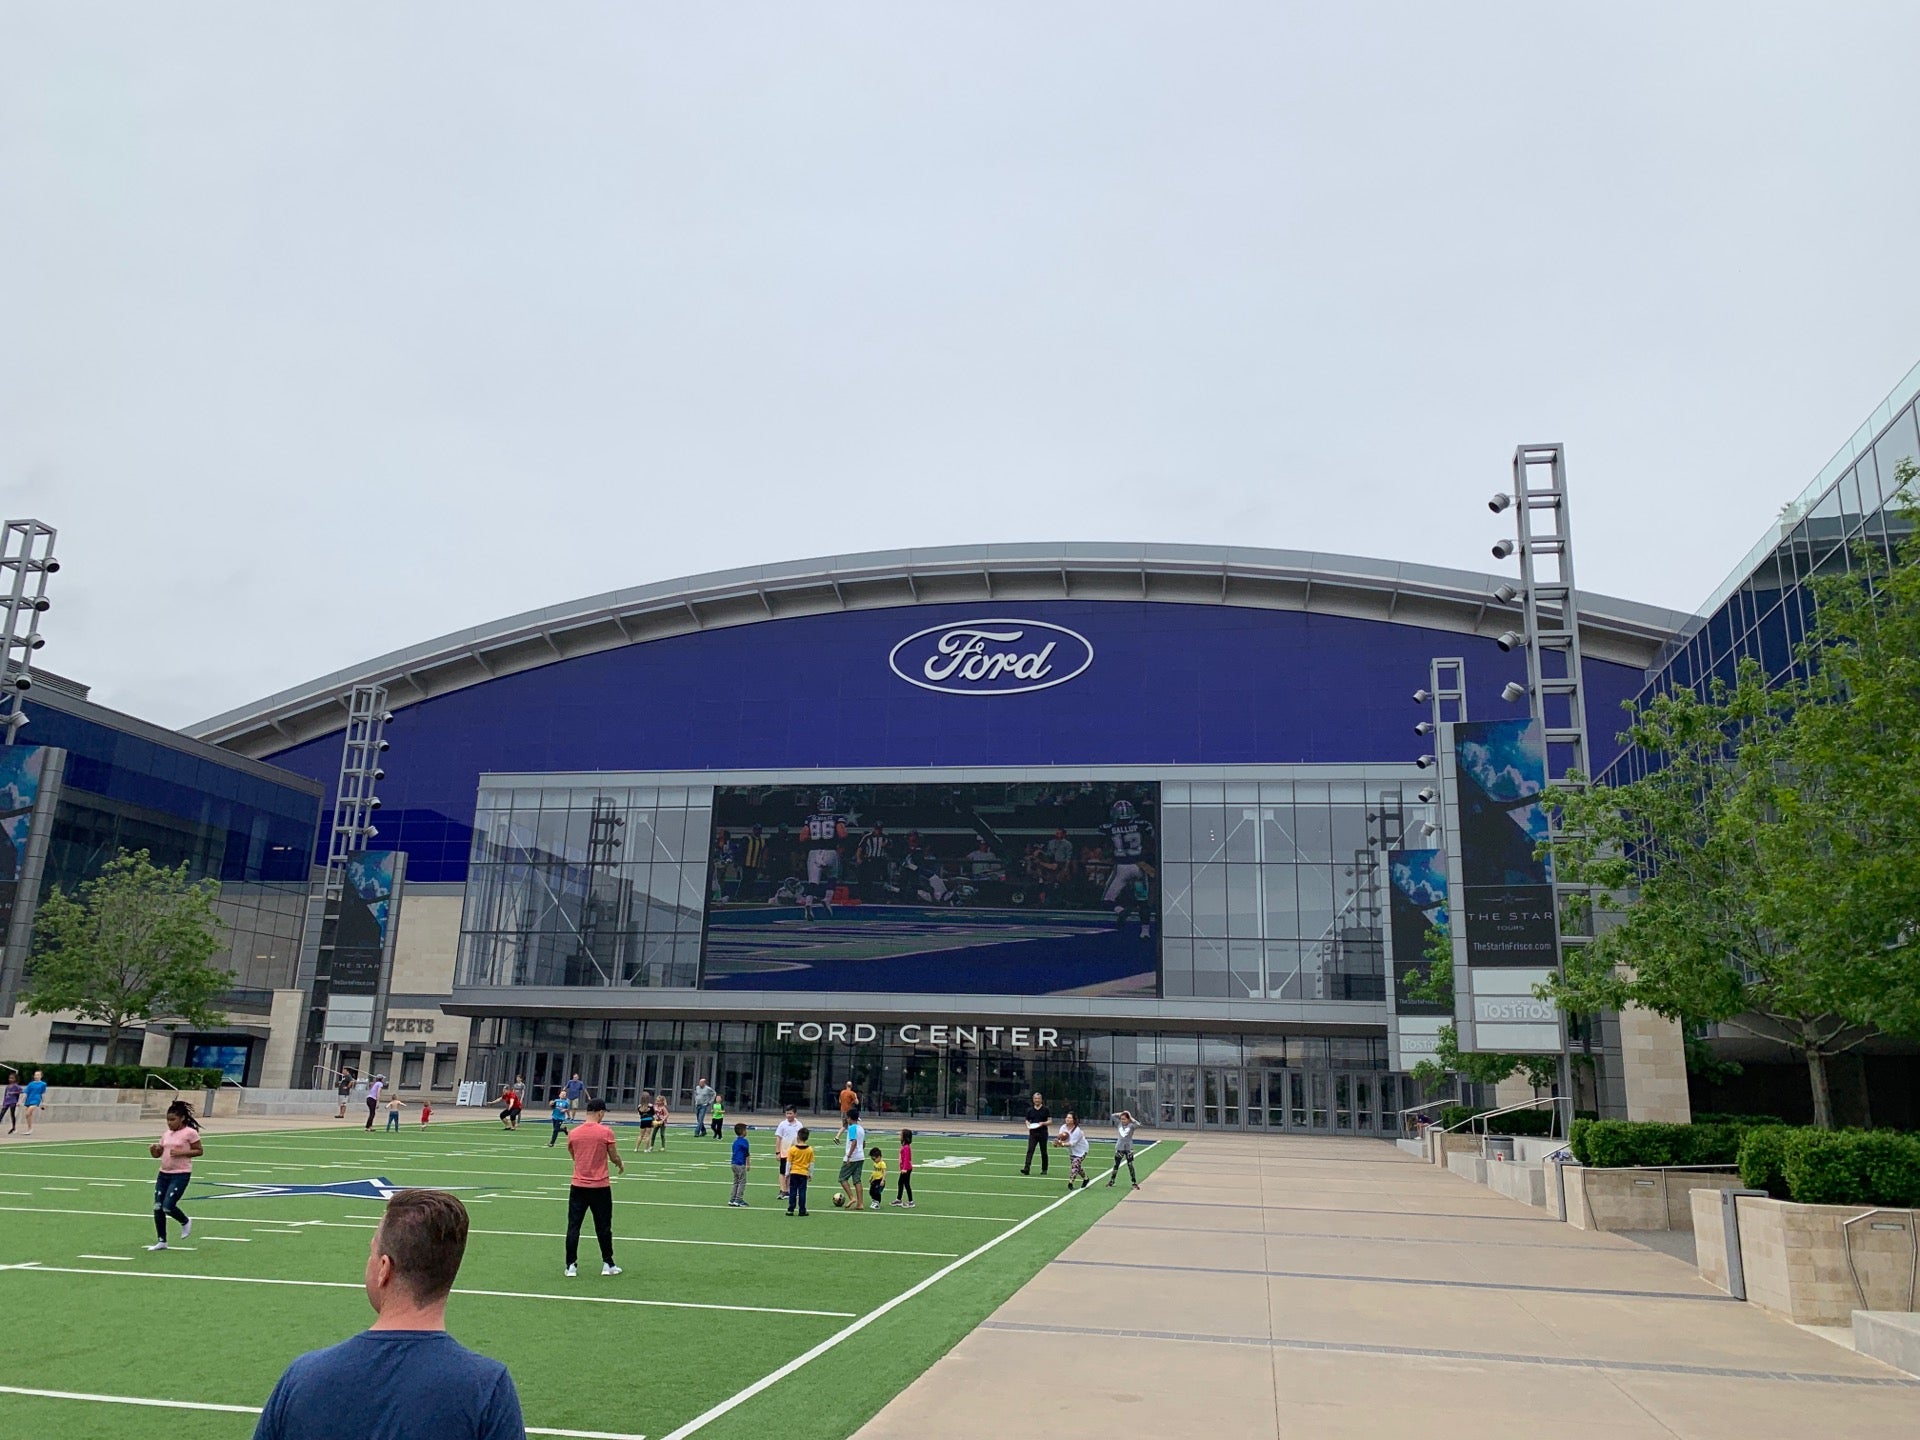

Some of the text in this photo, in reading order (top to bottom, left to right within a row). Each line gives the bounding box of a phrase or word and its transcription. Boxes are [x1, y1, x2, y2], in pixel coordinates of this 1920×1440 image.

[924, 630, 1057, 681] Ford
[1111, 825, 1138, 834] GALLUP
[1467, 911, 1553, 921] THE STAR
[1473, 941, 1552, 951] TheStarInFrisco.com
[384, 1018, 435, 1033] CKETS
[776, 1022, 1059, 1047] FORD CENTER
